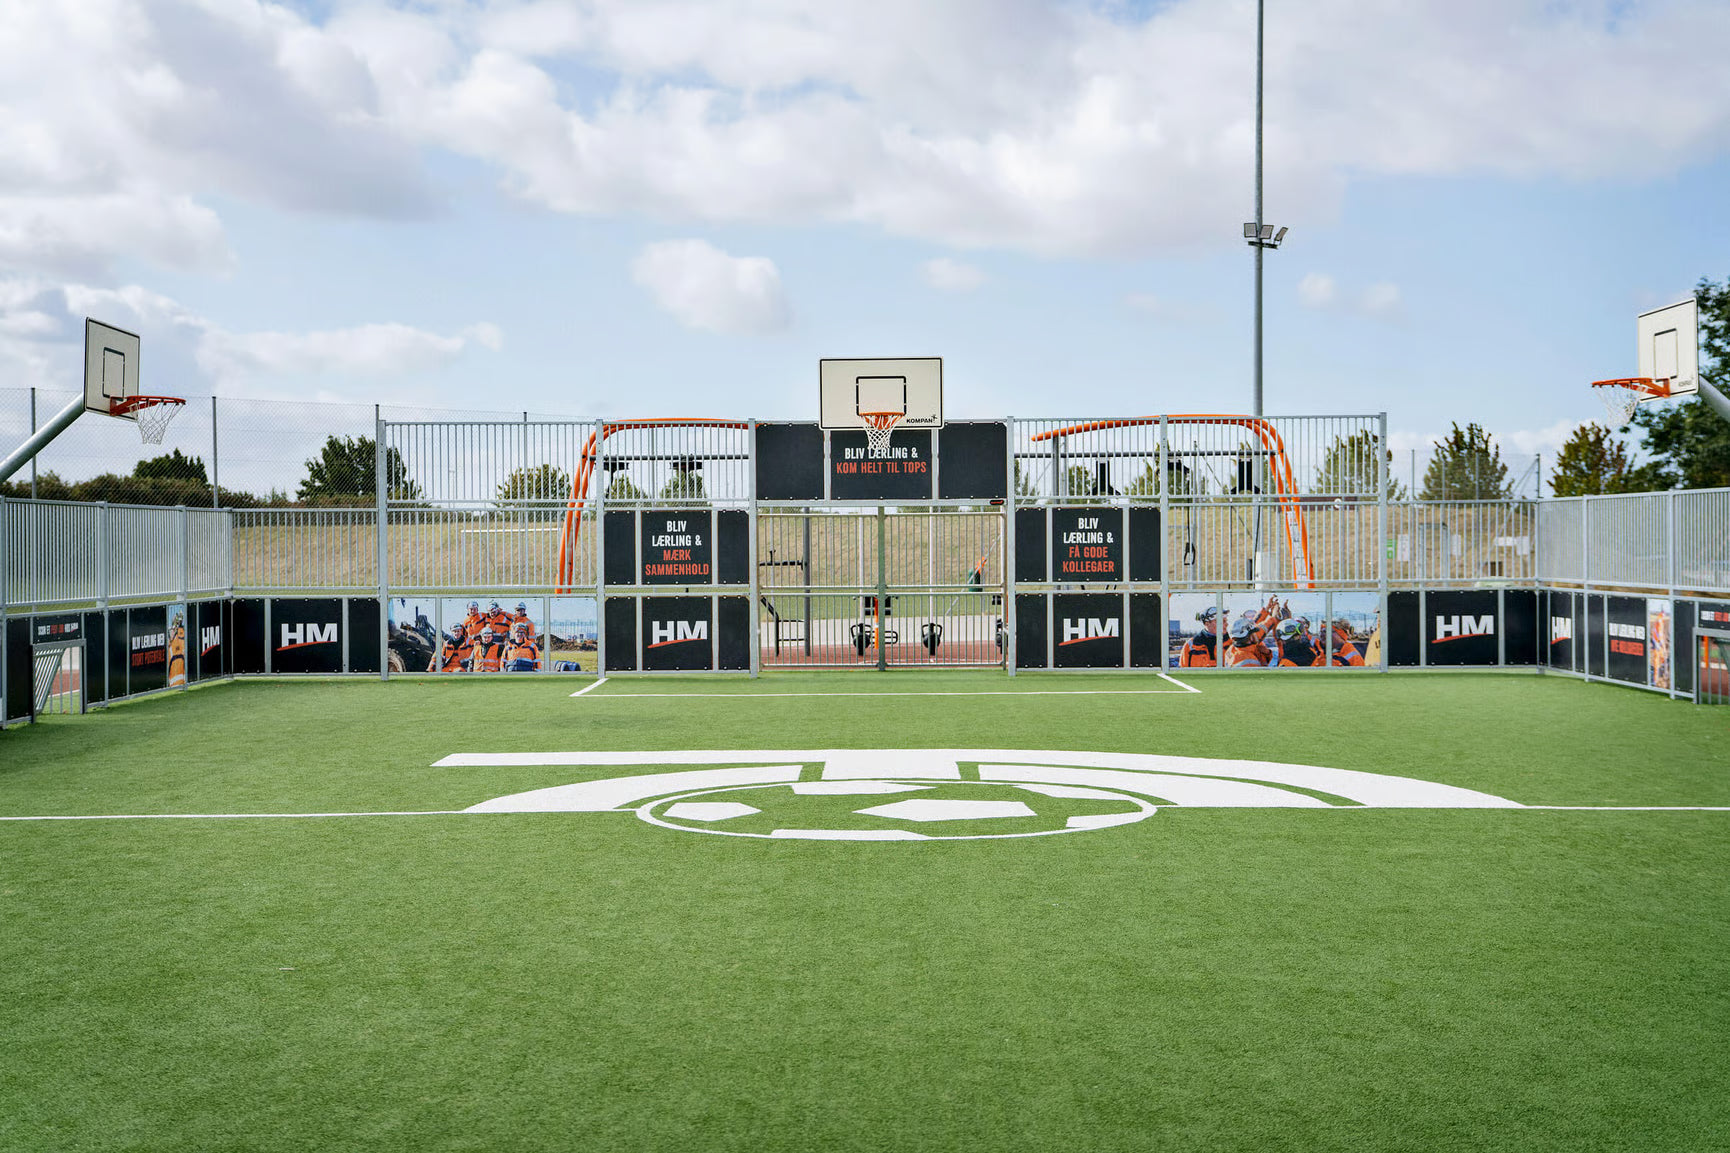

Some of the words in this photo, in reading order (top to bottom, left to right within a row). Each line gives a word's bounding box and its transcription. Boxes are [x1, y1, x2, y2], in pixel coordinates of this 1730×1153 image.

[844, 447, 865, 459] BLIV
[868, 447, 908, 459] LÆRLING
[911, 447, 919, 459] &
[836, 461, 857, 474] KOM
[861, 461, 884, 474] HELT
[886, 461, 900, 474] TIL
[903, 461, 927, 473] TOPS
[667, 520, 687, 532] BLIV
[1078, 517, 1099, 529] BLIV
[651, 534, 692, 546] LÆRLING
[695, 534, 702, 546] &
[1063, 532, 1103, 543] LÆRLING
[1106, 532, 1114, 543] &
[663, 549, 691, 561] MÆRK
[1069, 545, 1081, 558] FÅ
[1083, 546, 1108, 558] GODE
[645, 563, 709, 576] SAMMENHOLD
[1063, 561, 1115, 573] KOLLEGAER
[652, 620, 708, 642] HM
[1063, 617, 1119, 641] HM
[1436, 614, 1495, 642] HM
[1551, 616, 1572, 641] HM
[201, 625, 220, 652] HM
[281, 623, 338, 648] HM
